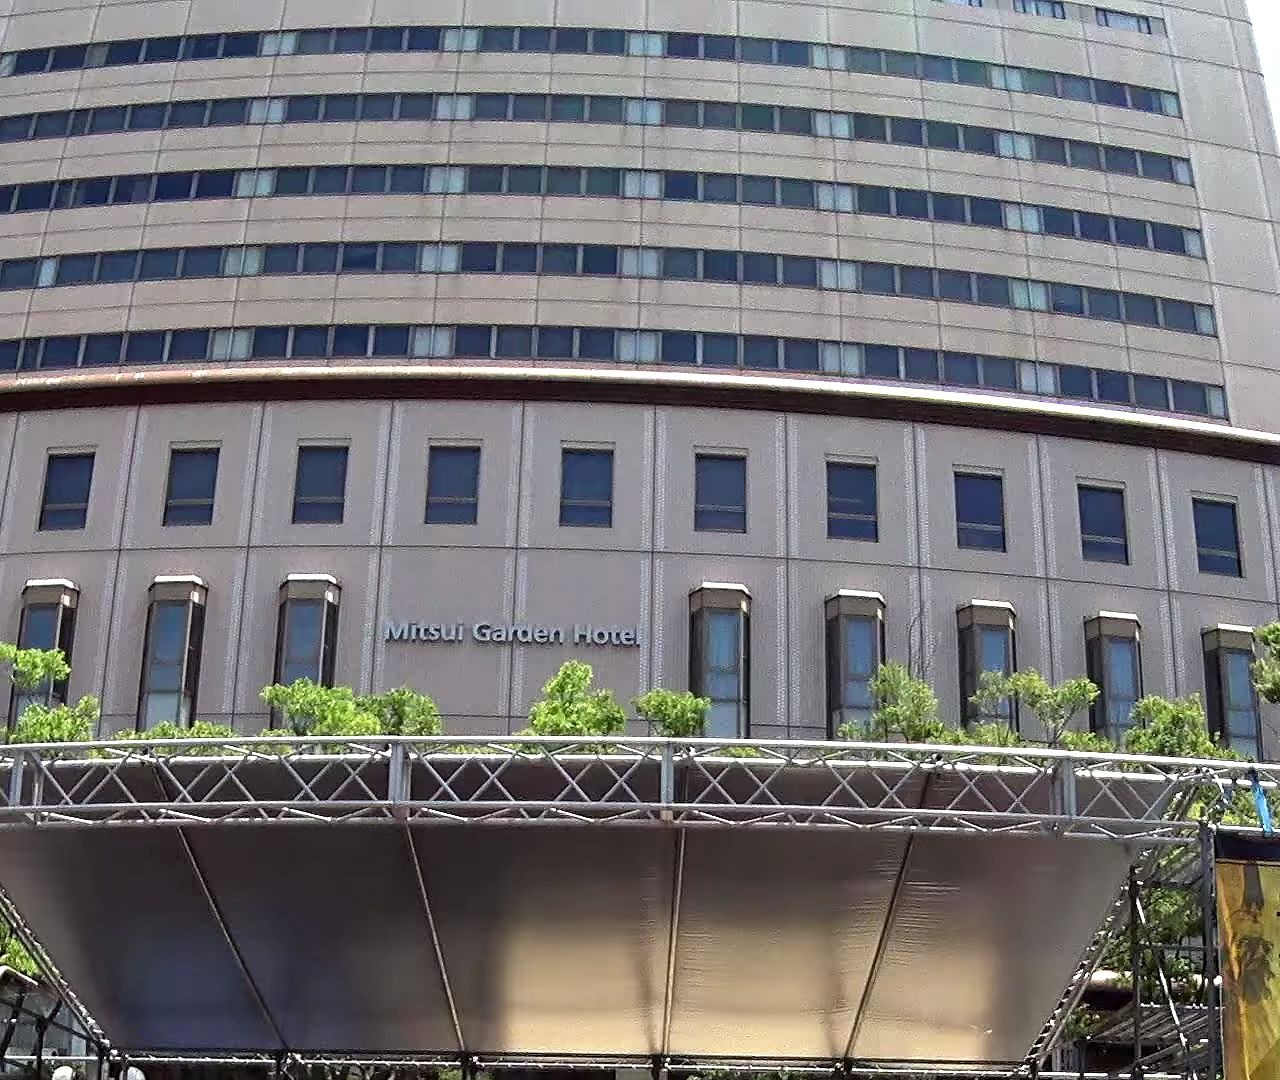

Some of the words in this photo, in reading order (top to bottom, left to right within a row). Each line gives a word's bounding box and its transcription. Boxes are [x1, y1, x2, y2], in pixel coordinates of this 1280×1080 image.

[384, 622, 464, 643] Mitsui
[472, 622, 565, 646] Garden
[573, 623, 641, 646] Hotel
